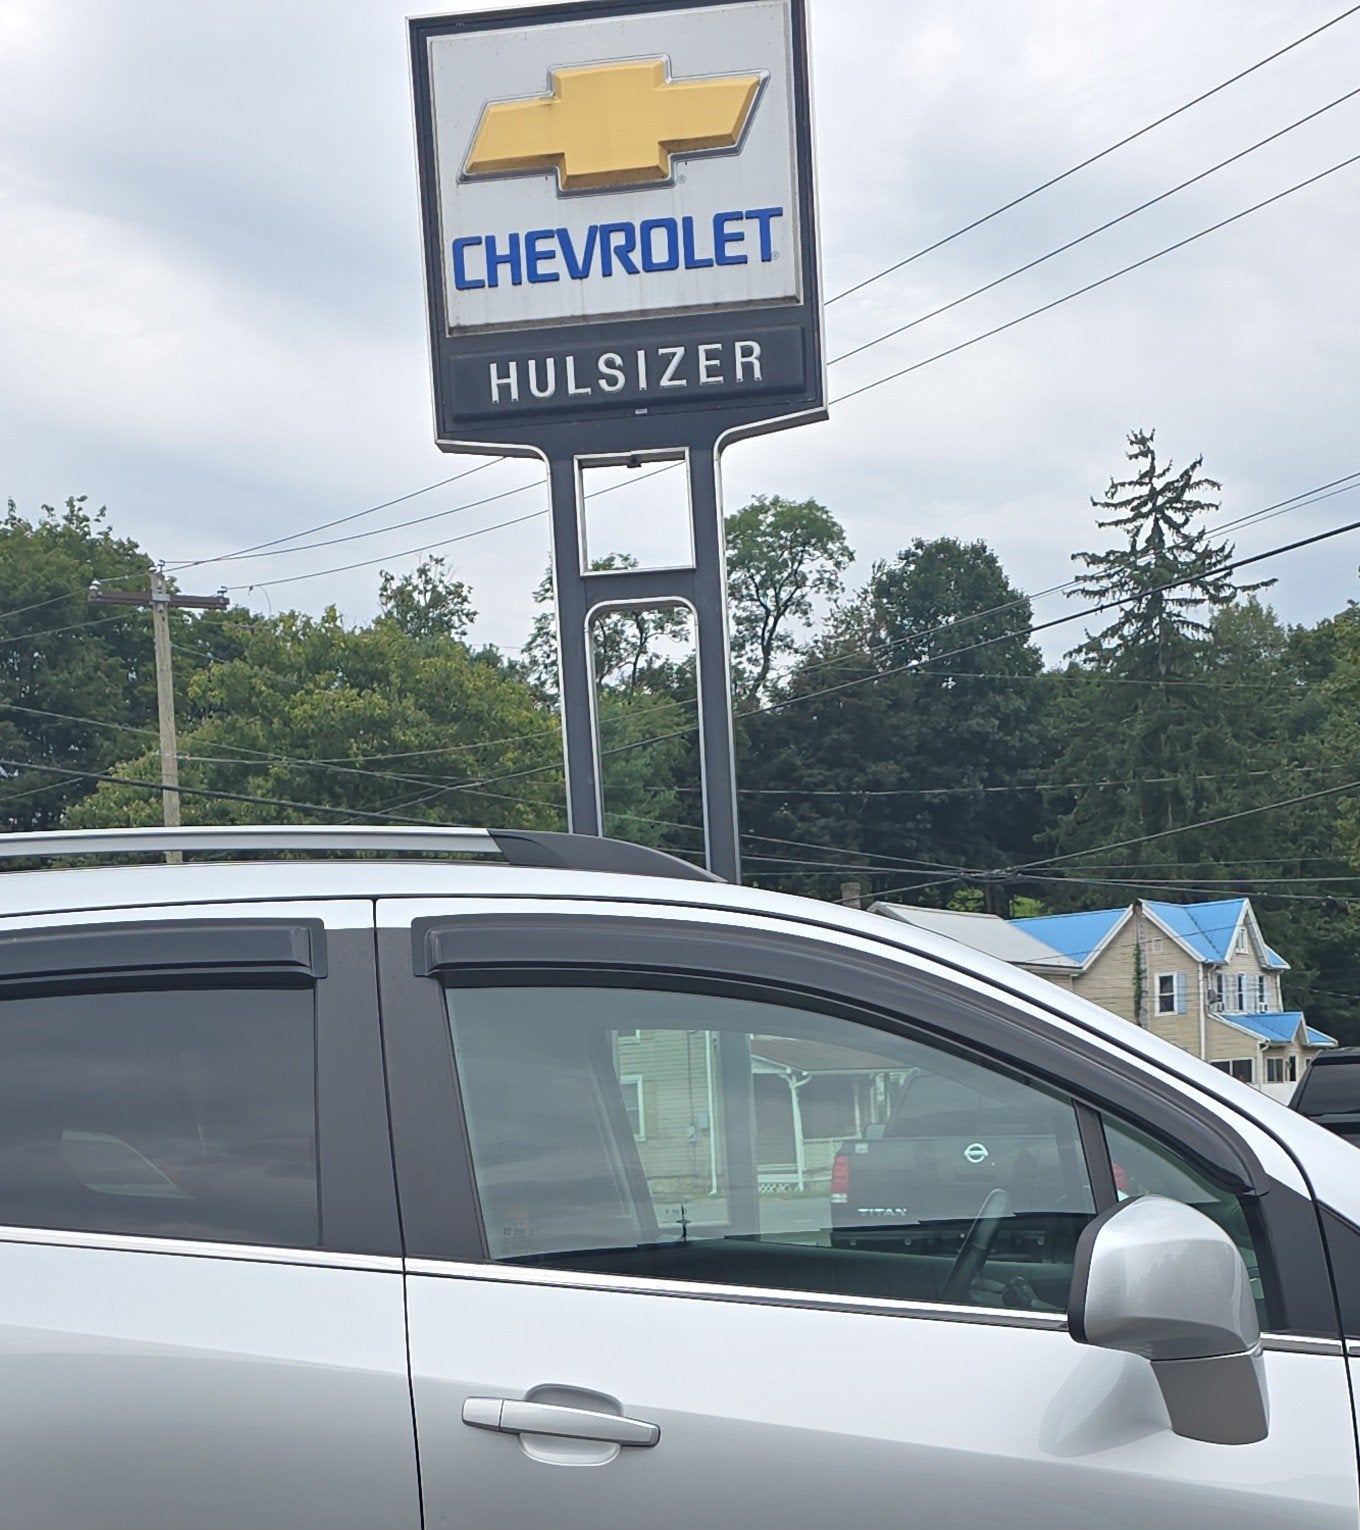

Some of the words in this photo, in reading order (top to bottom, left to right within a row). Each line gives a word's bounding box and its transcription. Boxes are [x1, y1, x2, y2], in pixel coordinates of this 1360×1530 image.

[451, 206, 784, 291] CHEVROLET
[489, 339, 763, 403] HULSIZER
[857, 1207, 907, 1217] TITAN
